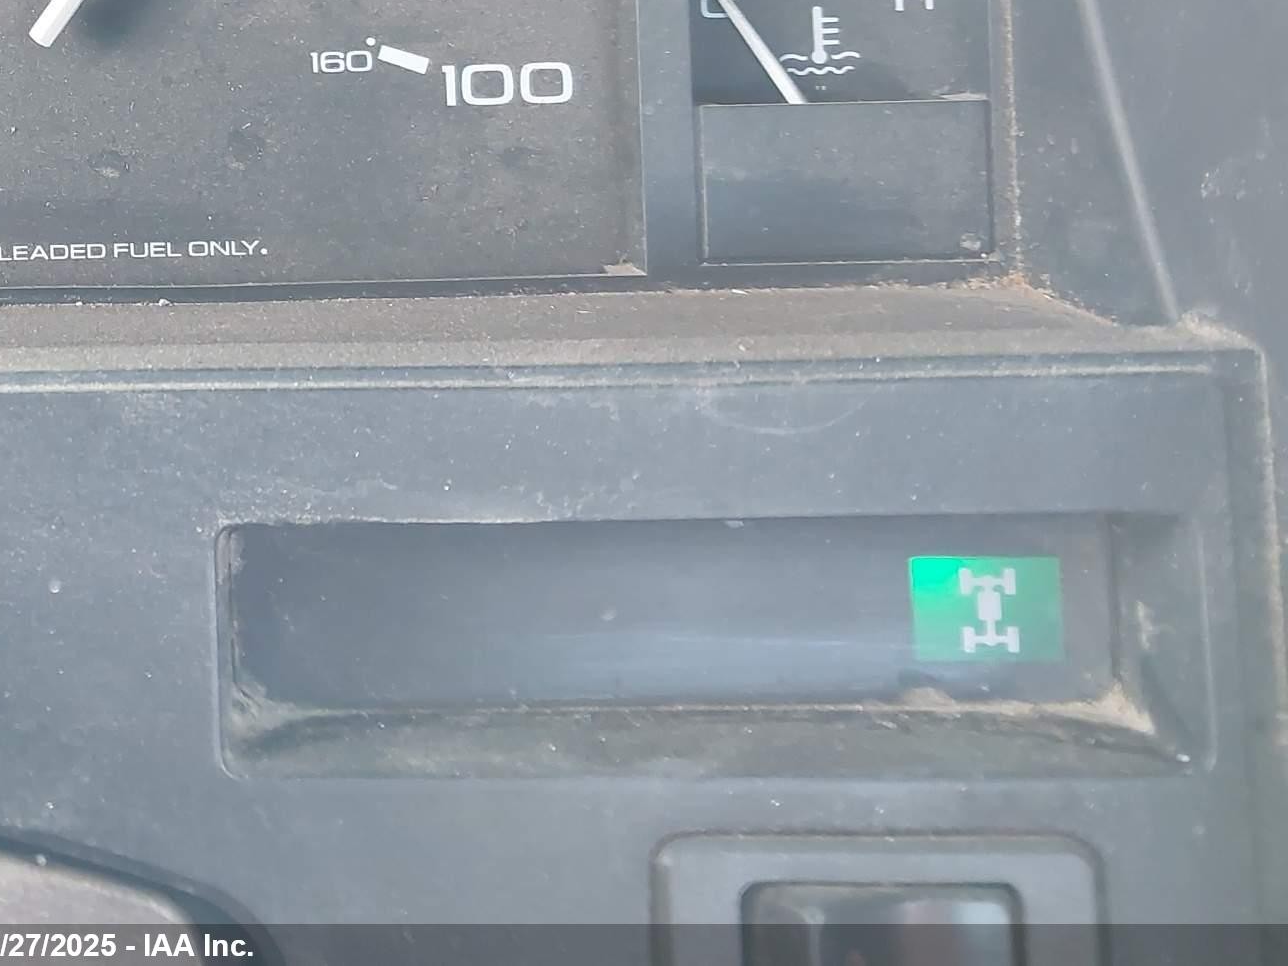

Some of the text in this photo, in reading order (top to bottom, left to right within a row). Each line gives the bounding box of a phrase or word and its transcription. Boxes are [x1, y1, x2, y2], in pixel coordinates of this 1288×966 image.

[311, 51, 372, 72] 160
[442, 62, 573, 106] 100
[113, 241, 183, 258] FUEL
[187, 240, 268, 256] ONLY.
